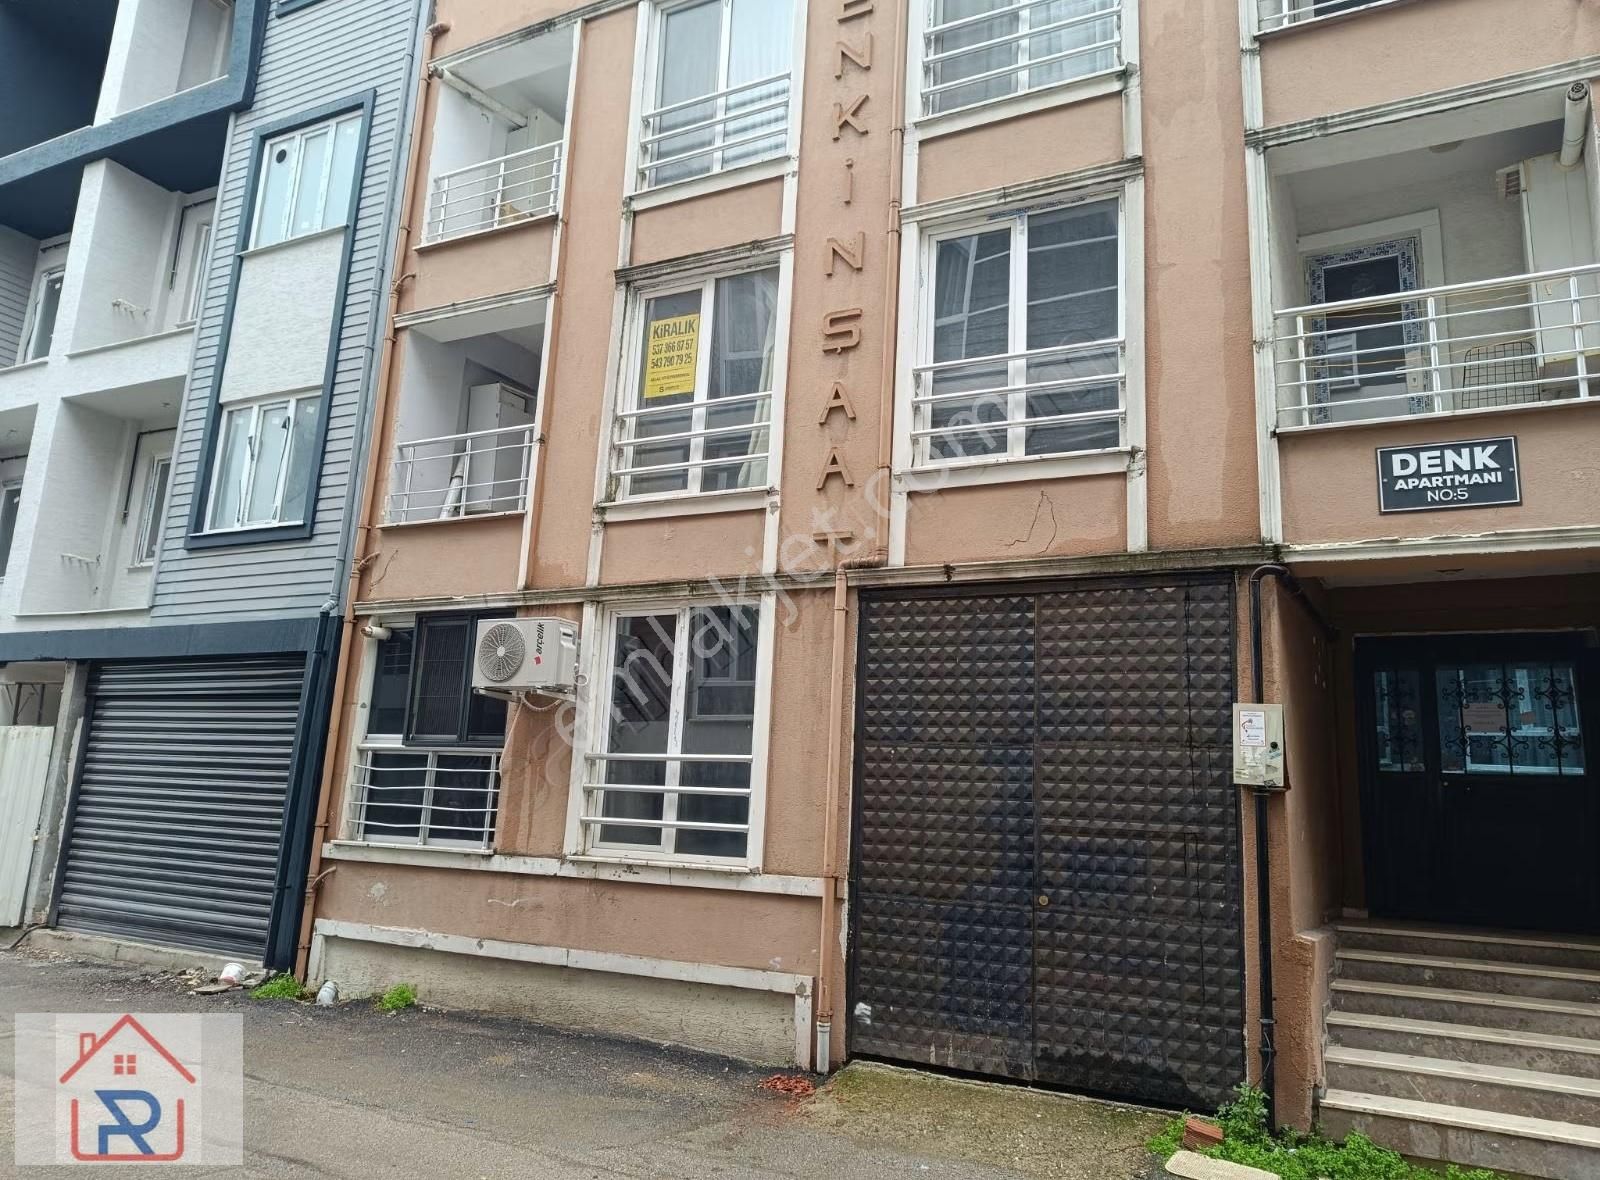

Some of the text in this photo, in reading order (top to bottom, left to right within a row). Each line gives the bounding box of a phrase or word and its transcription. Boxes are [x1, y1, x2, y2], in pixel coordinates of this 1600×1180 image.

[652, 343, 664, 355] 537
[685, 338, 694, 350] 57
[651, 357, 663, 369] 543
[684, 352, 692, 364] 25
[1391, 445, 1501, 477] DENK
[1394, 471, 1503, 491] APARTMANI
[1426, 487, 1469, 503] NO:5
[535, 622, 545, 655] arçelik
